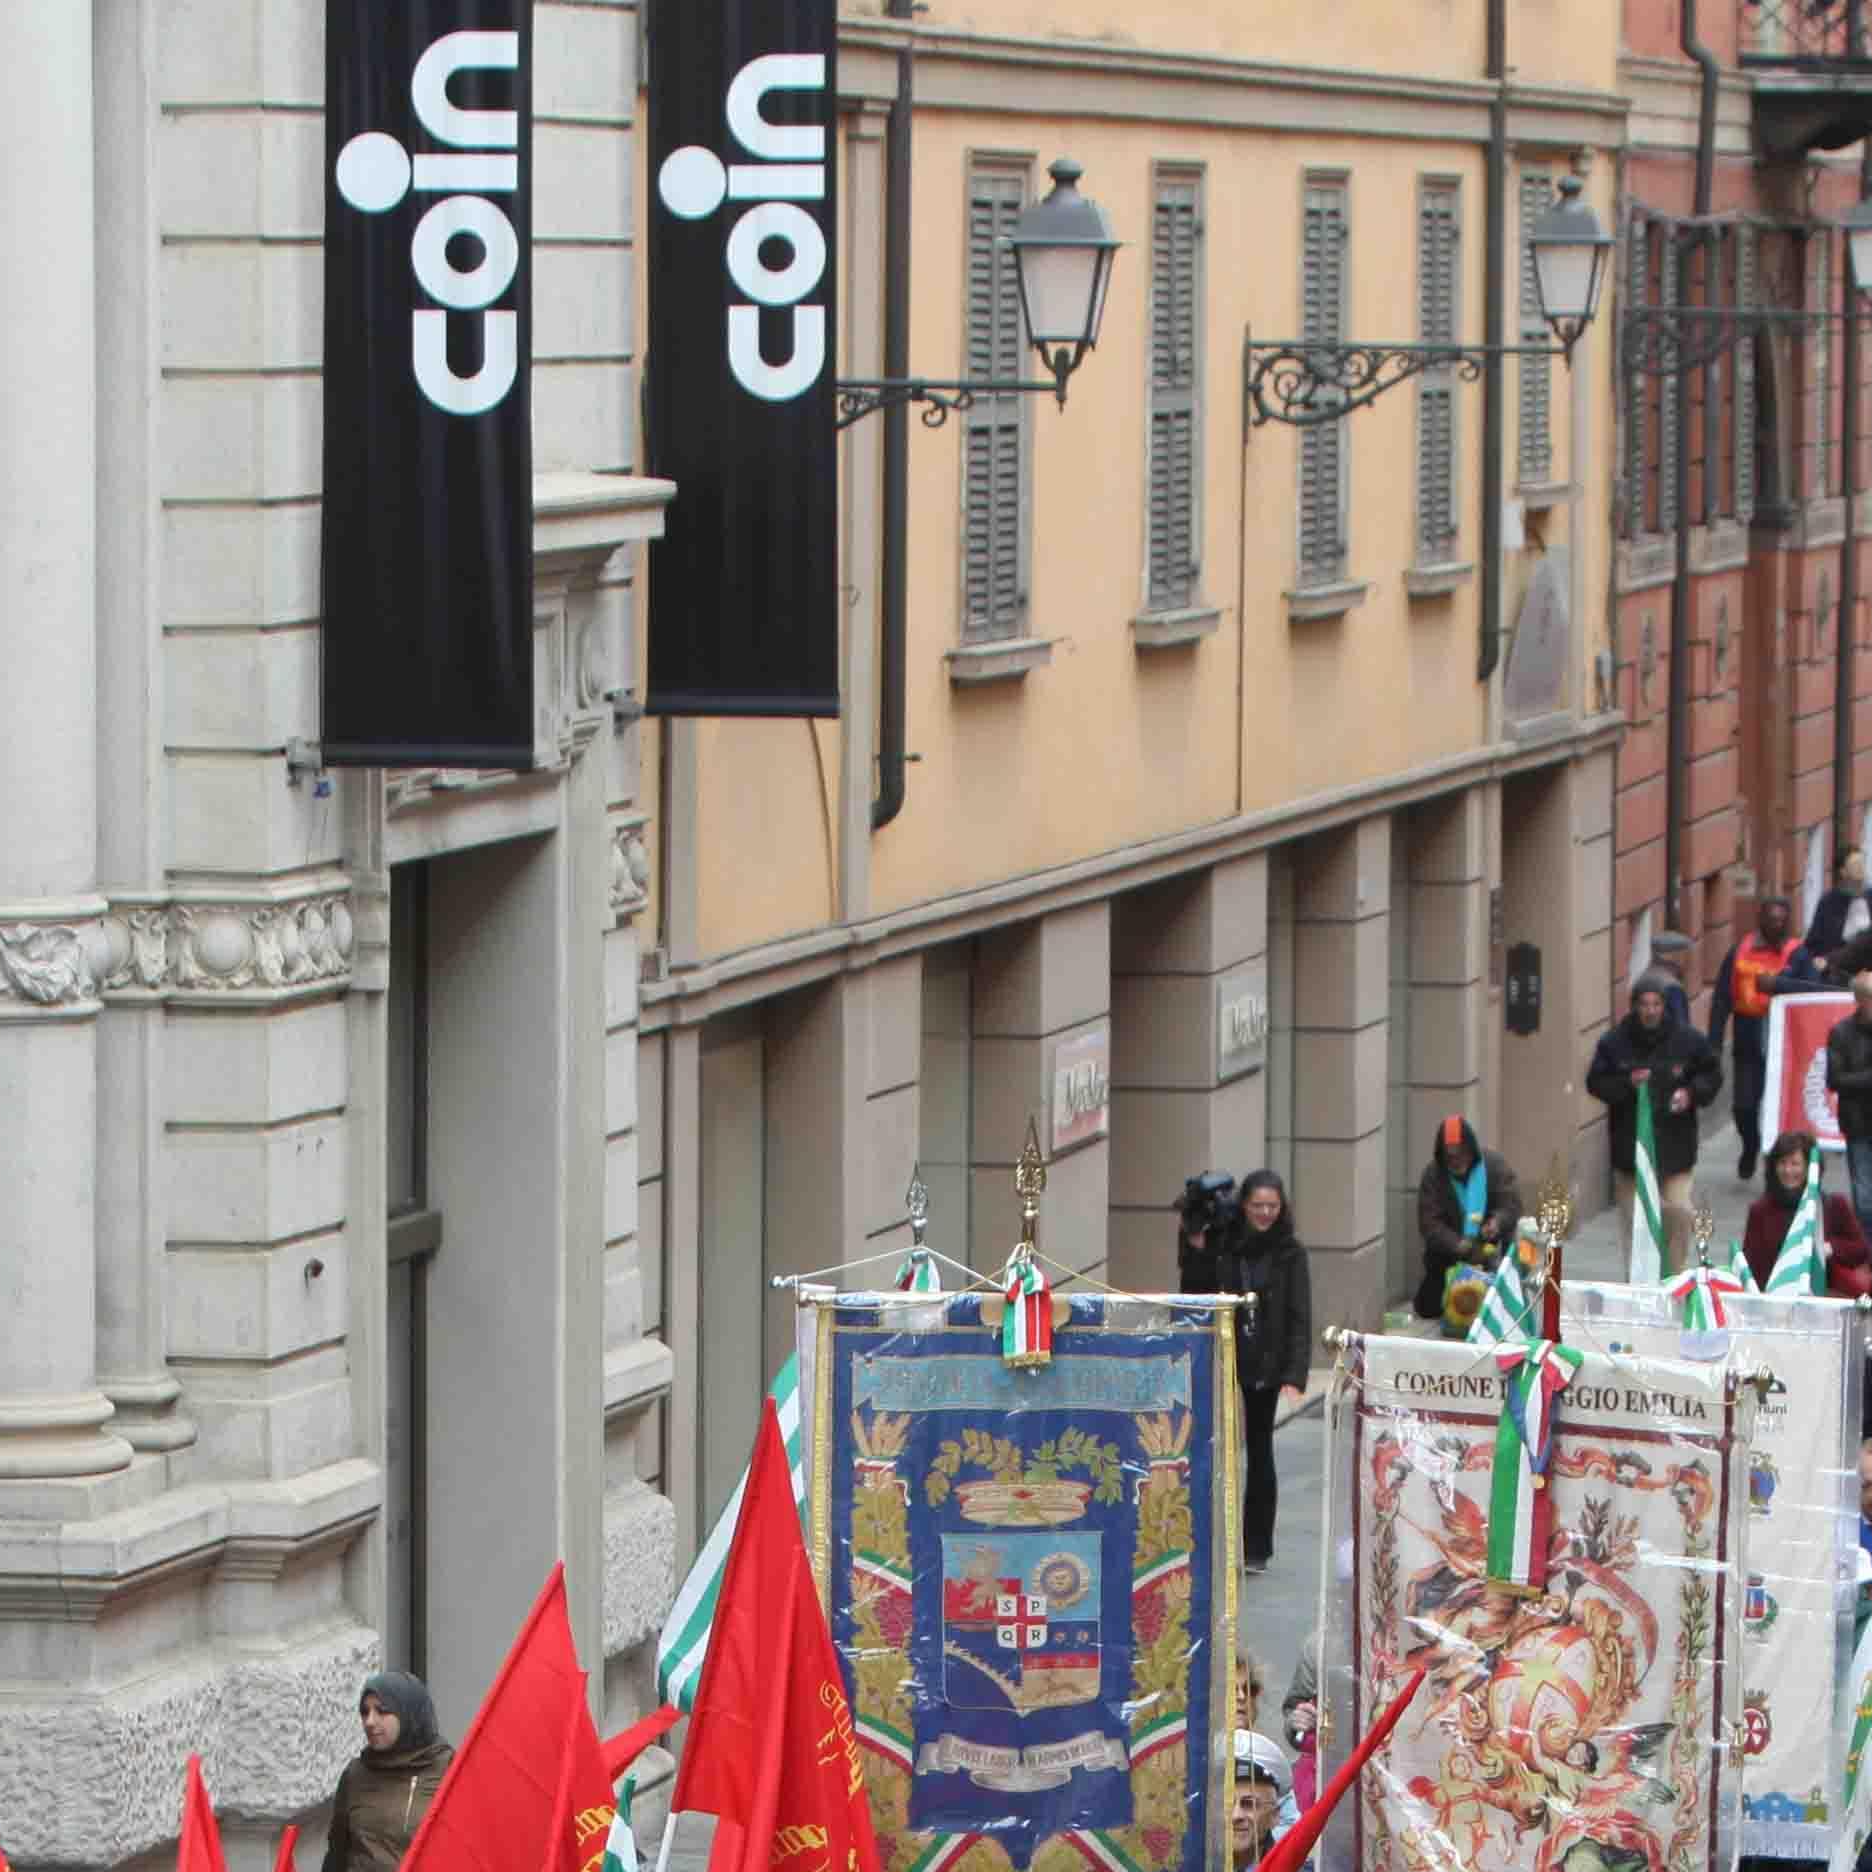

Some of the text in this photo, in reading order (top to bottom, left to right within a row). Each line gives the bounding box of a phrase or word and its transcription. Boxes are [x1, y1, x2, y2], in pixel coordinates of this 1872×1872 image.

[335, 31, 519, 416] coin
[659, 53, 826, 401] coin
[1394, 1370, 1707, 1419] COMUNE GGIO EMILIA
